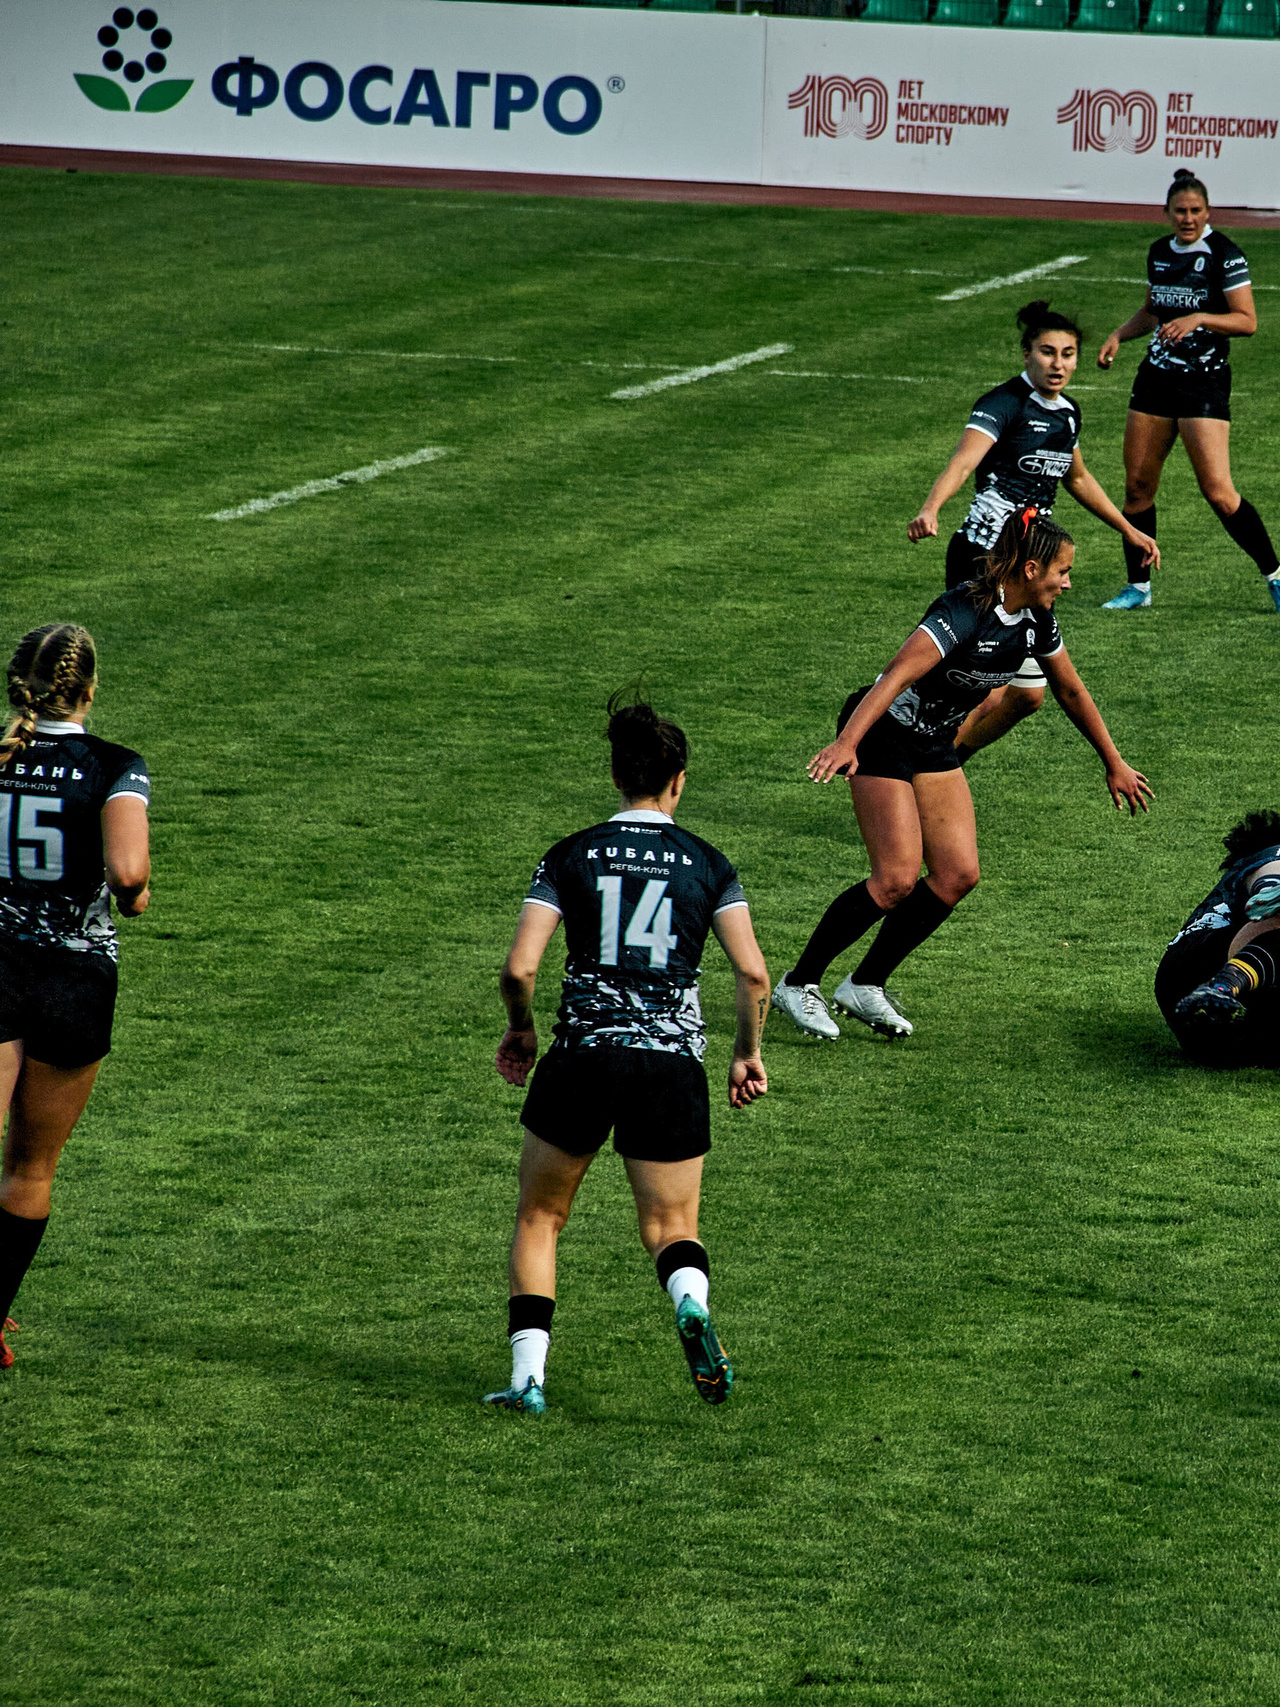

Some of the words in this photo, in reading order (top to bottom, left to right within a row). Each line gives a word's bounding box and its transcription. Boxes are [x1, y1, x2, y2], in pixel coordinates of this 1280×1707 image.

[210, 56, 603, 136] ФОСАГРО
[898, 80, 924, 100] ЛЕТ
[788, 75, 889, 140] 100
[897, 102, 1009, 126] МОСКОВСКОМУ
[1167, 93, 1194, 113] ЛЕТ
[1057, 89, 1158, 154] 100
[1166, 116, 1279, 139] МОСКОВСКОМУ
[896, 124, 952, 145] СПОРТУ
[1165, 138, 1222, 159] СПОРТУ
[609, 863, 670, 875] РЕГБИ-КЛУБ
[597, 876, 678, 969] 14
